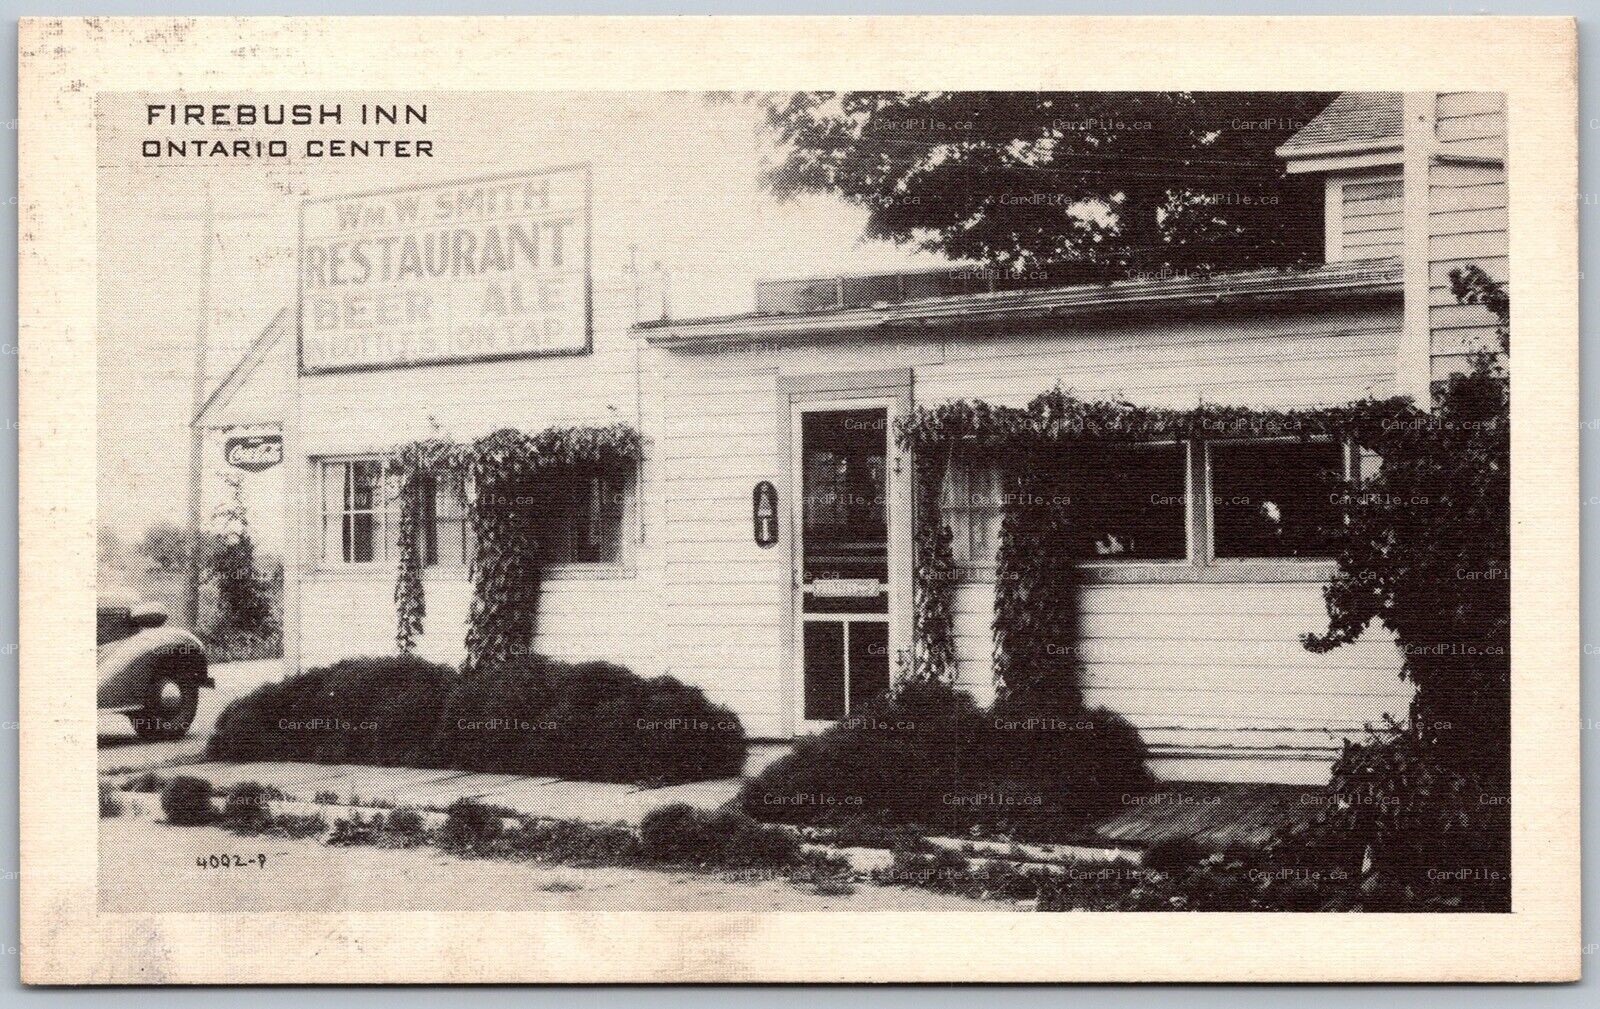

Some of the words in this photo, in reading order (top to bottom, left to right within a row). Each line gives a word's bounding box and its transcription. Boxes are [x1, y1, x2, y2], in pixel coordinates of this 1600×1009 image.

[435, 179, 551, 220] SMITH
[306, 217, 574, 289] RESTAURANT
[313, 290, 435, 332] BEER
[480, 277, 567, 318] ALE
